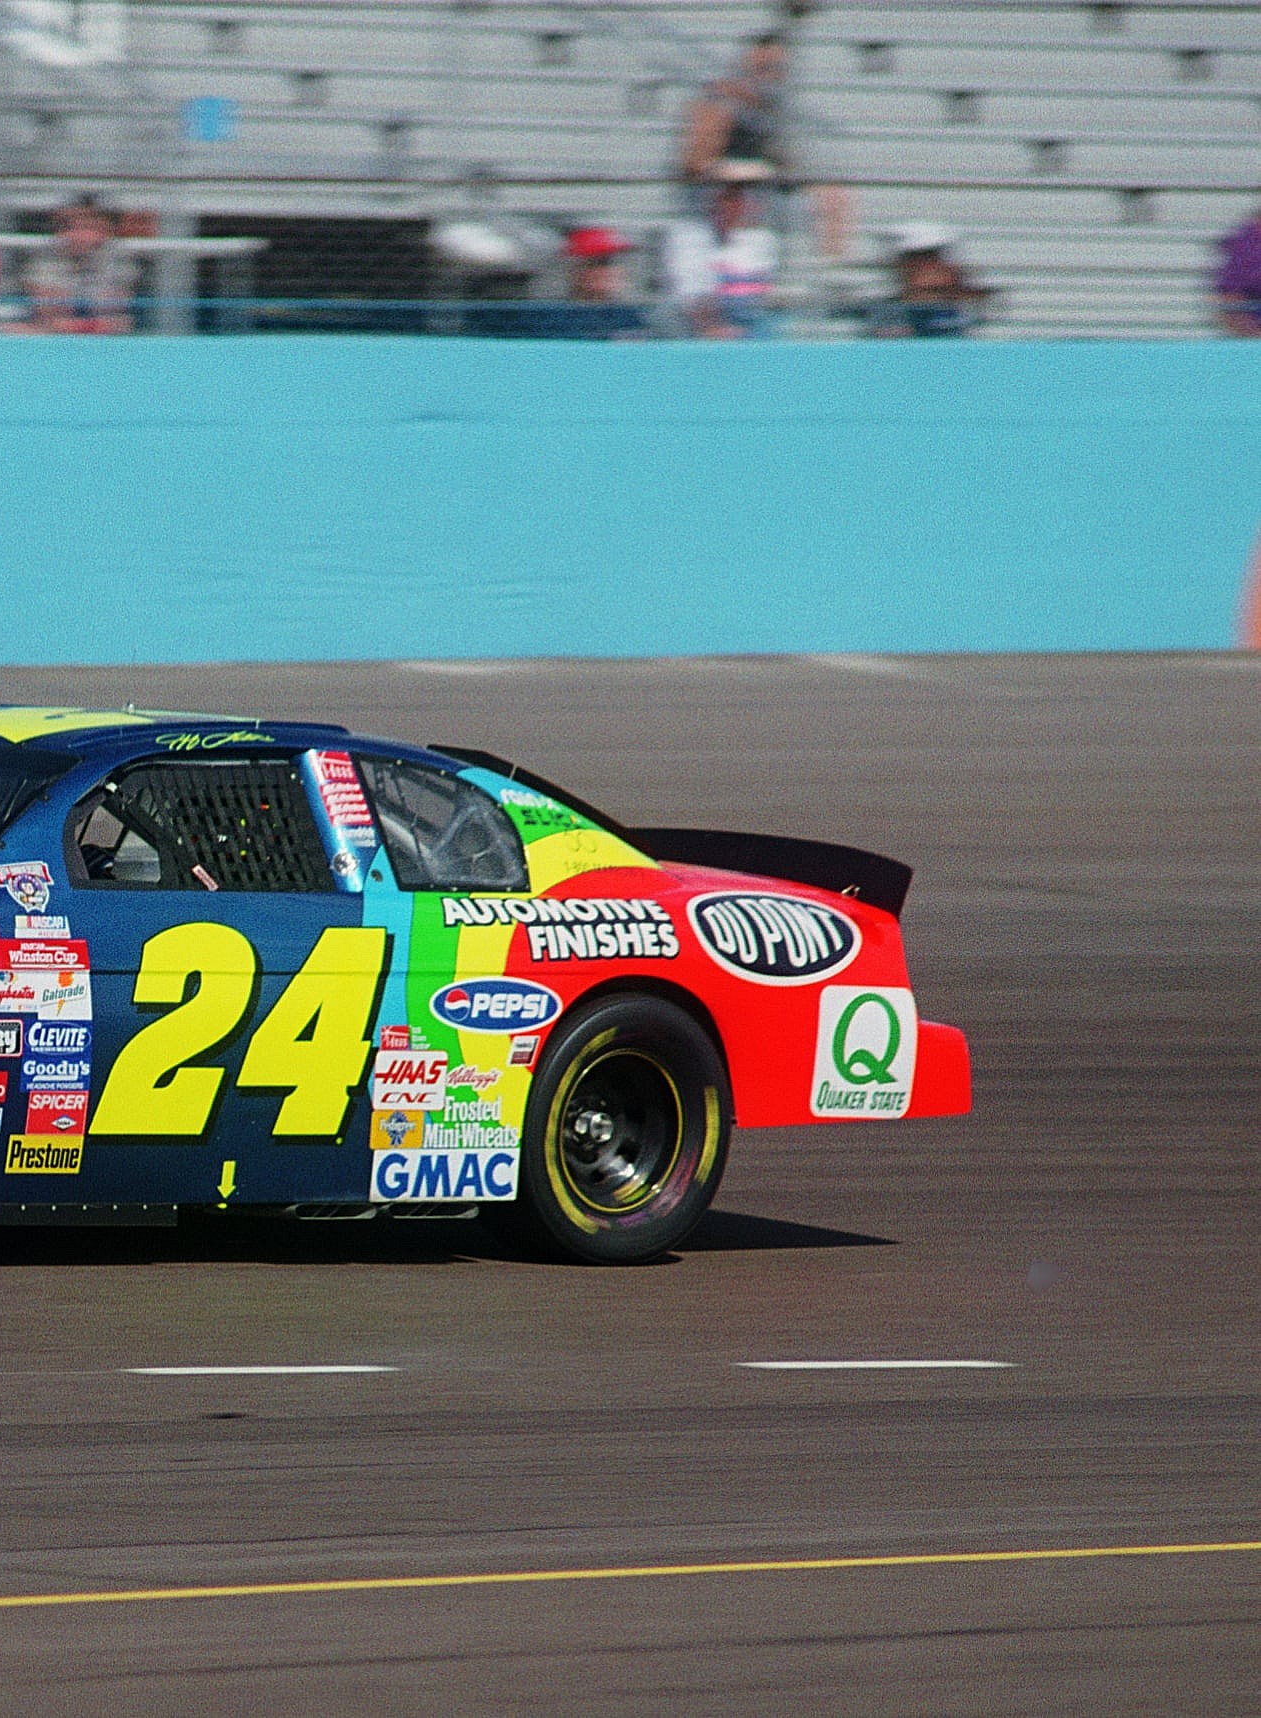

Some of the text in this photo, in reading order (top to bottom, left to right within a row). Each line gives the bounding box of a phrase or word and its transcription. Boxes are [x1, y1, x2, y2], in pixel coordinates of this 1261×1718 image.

[441, 897, 671, 926] AUTOMOTIVE
[527, 923, 680, 960] FINISHES
[9, 950, 78, 966] Winston Cup
[42, 984, 85, 1002] Gatorade
[471, 993, 549, 1019] PEPSI
[28, 1022, 87, 1047] CLEVITE
[88, 921, 386, 1135] 24
[832, 992, 901, 1085] Q
[23, 1060, 90, 1081] Goody's
[375, 1059, 447, 1085] HAAS
[448, 1066, 500, 1089] Kellogg's
[30, 1094, 85, 1110] SPICER
[381, 1091, 437, 1104] CNC
[443, 1096, 501, 1122] Frosted
[869, 1091, 906, 1111] STATE
[423, 1123, 519, 1148] Mini-Wheats
[8, 1140, 79, 1169] Prestone
[376, 1153, 515, 1199] GMAC
